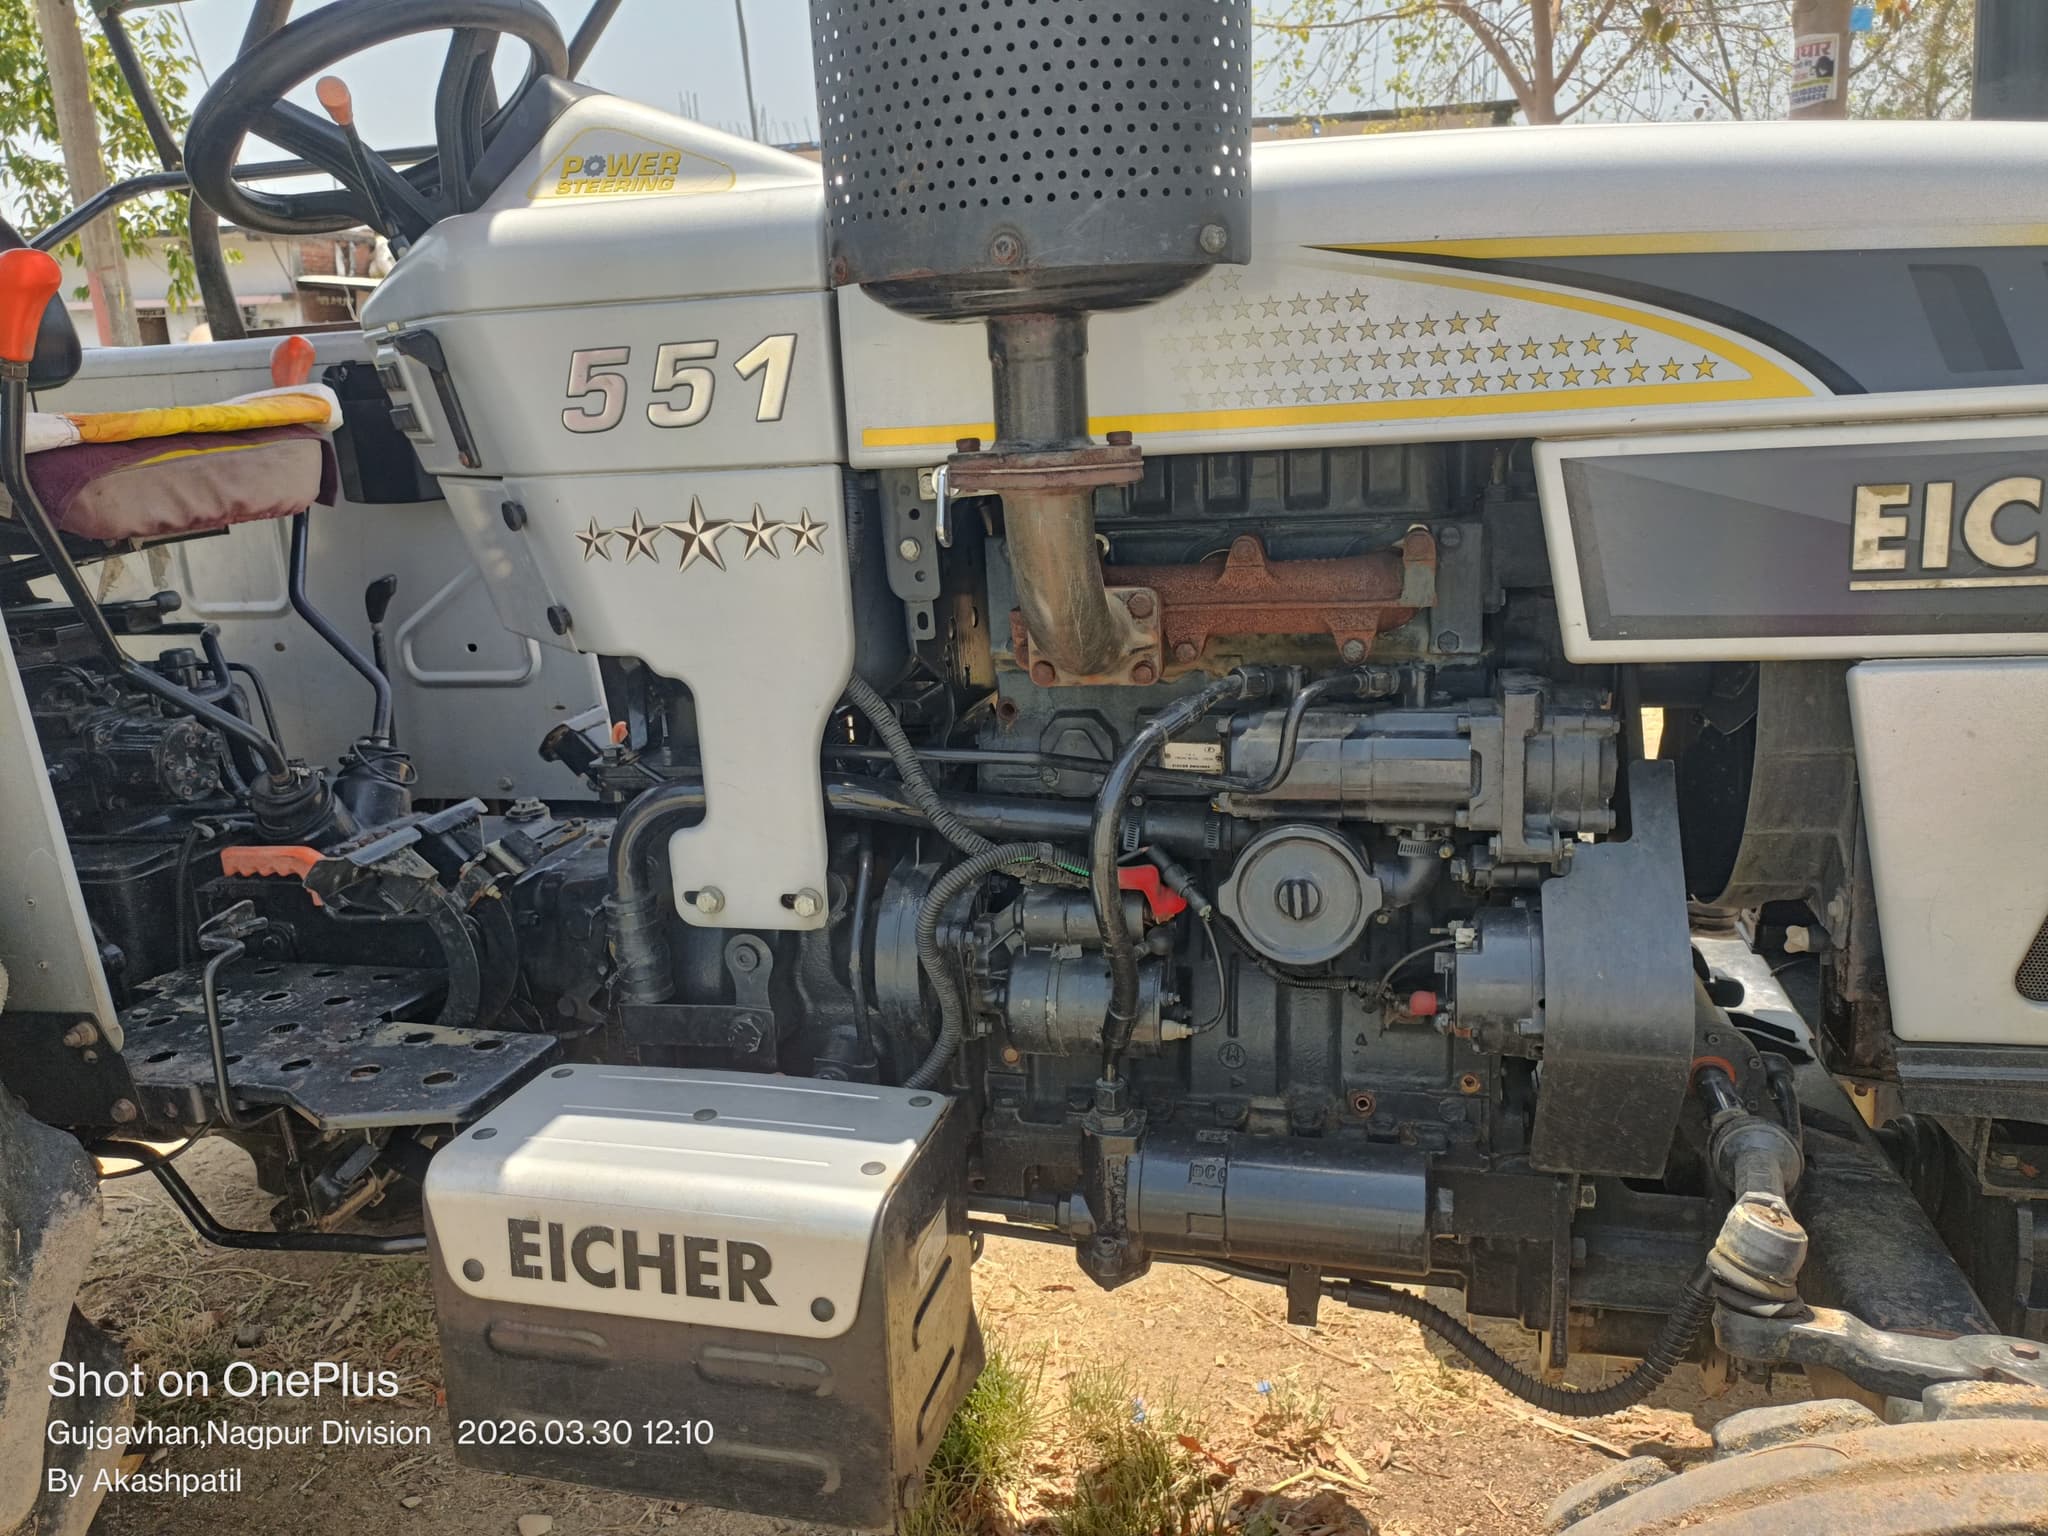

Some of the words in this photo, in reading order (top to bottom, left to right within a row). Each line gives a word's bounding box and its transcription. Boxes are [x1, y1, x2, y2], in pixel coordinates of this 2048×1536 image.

[556, 176, 676, 195] STEERING
[560, 151, 682, 179] POWER
[561, 333, 798, 434] 551
[1850, 475, 2044, 572] EIC
[507, 1217, 779, 1307] EICHER
